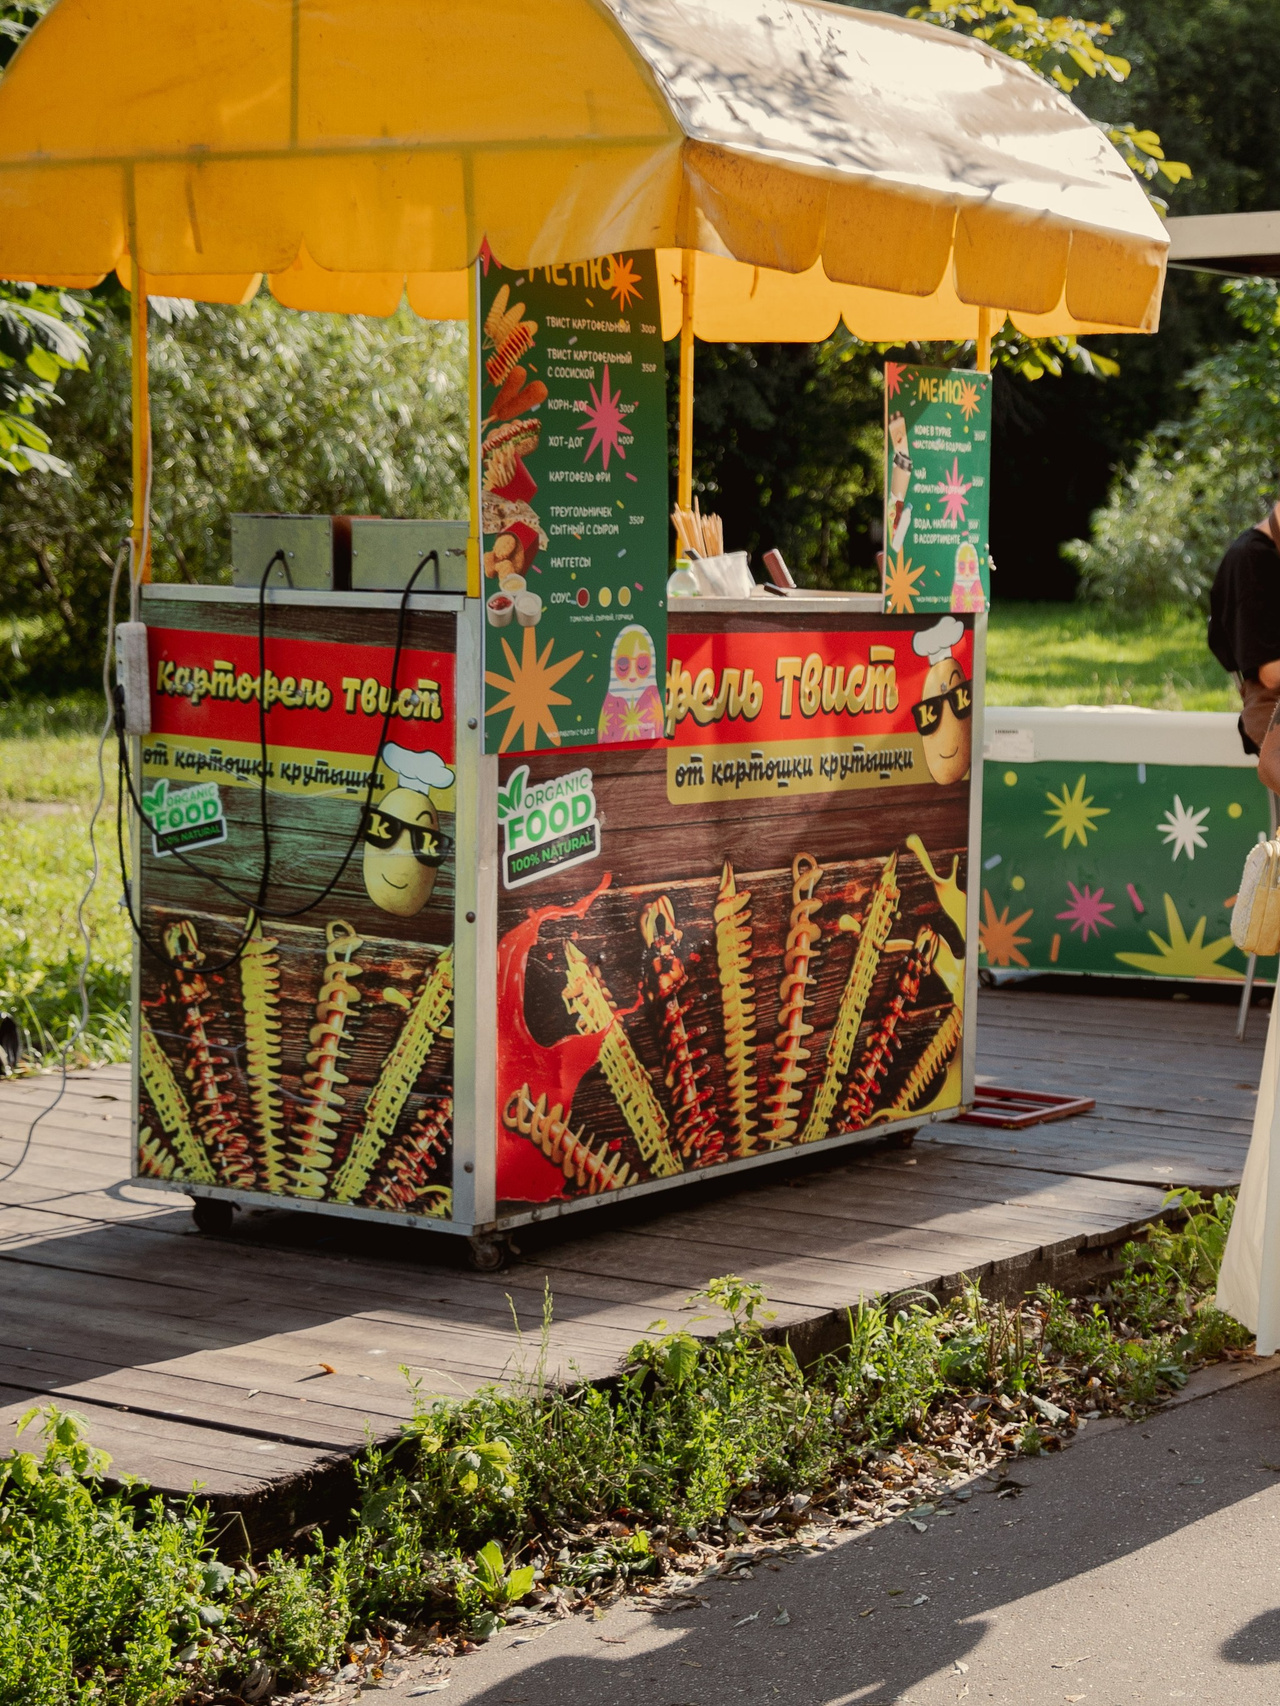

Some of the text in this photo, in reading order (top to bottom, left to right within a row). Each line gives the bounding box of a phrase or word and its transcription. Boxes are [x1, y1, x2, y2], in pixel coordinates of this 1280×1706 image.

[546, 316, 571, 328] ТВИСТ
[572, 319, 631, 333] КАРТОФЕЛЬНЫЙ
[547, 348, 632, 364] ТВИСТ КАРТОФЕЛЬНЫЙ
[547, 366, 595, 379] С СОСИСКОЙ
[918, 377, 962, 405] МЕНЮ
[548, 399, 588, 413] КОРН-ДОГ
[548, 436, 584, 449] ХОТ-ДОГ
[549, 471, 611, 482] КАРТОФЕЛЬ ФРИ
[550, 506, 613, 517] ТРЕУГОЛЬНИЧЕК
[550, 522, 619, 535] СЫТНЫЙ С СЫРОМ
[550, 557, 591, 568] НАГГЕТСЫ
[550, 592, 571, 603] СОУС
[156, 660, 443, 721] Картофель Твист
[776, 645, 899, 720] Твист
[143, 742, 385, 794] от картошки крутышки
[675, 743, 914, 789] от картошки крутышки
[167, 785, 215, 806] ORGANIC
[524, 773, 589, 809] ORGANIC
[155, 799, 218, 832] FOOD
[508, 794, 592, 851] FOOD
[181, 825, 221, 840] NATURAL
[511, 833, 593, 873] 100% NATURAL
